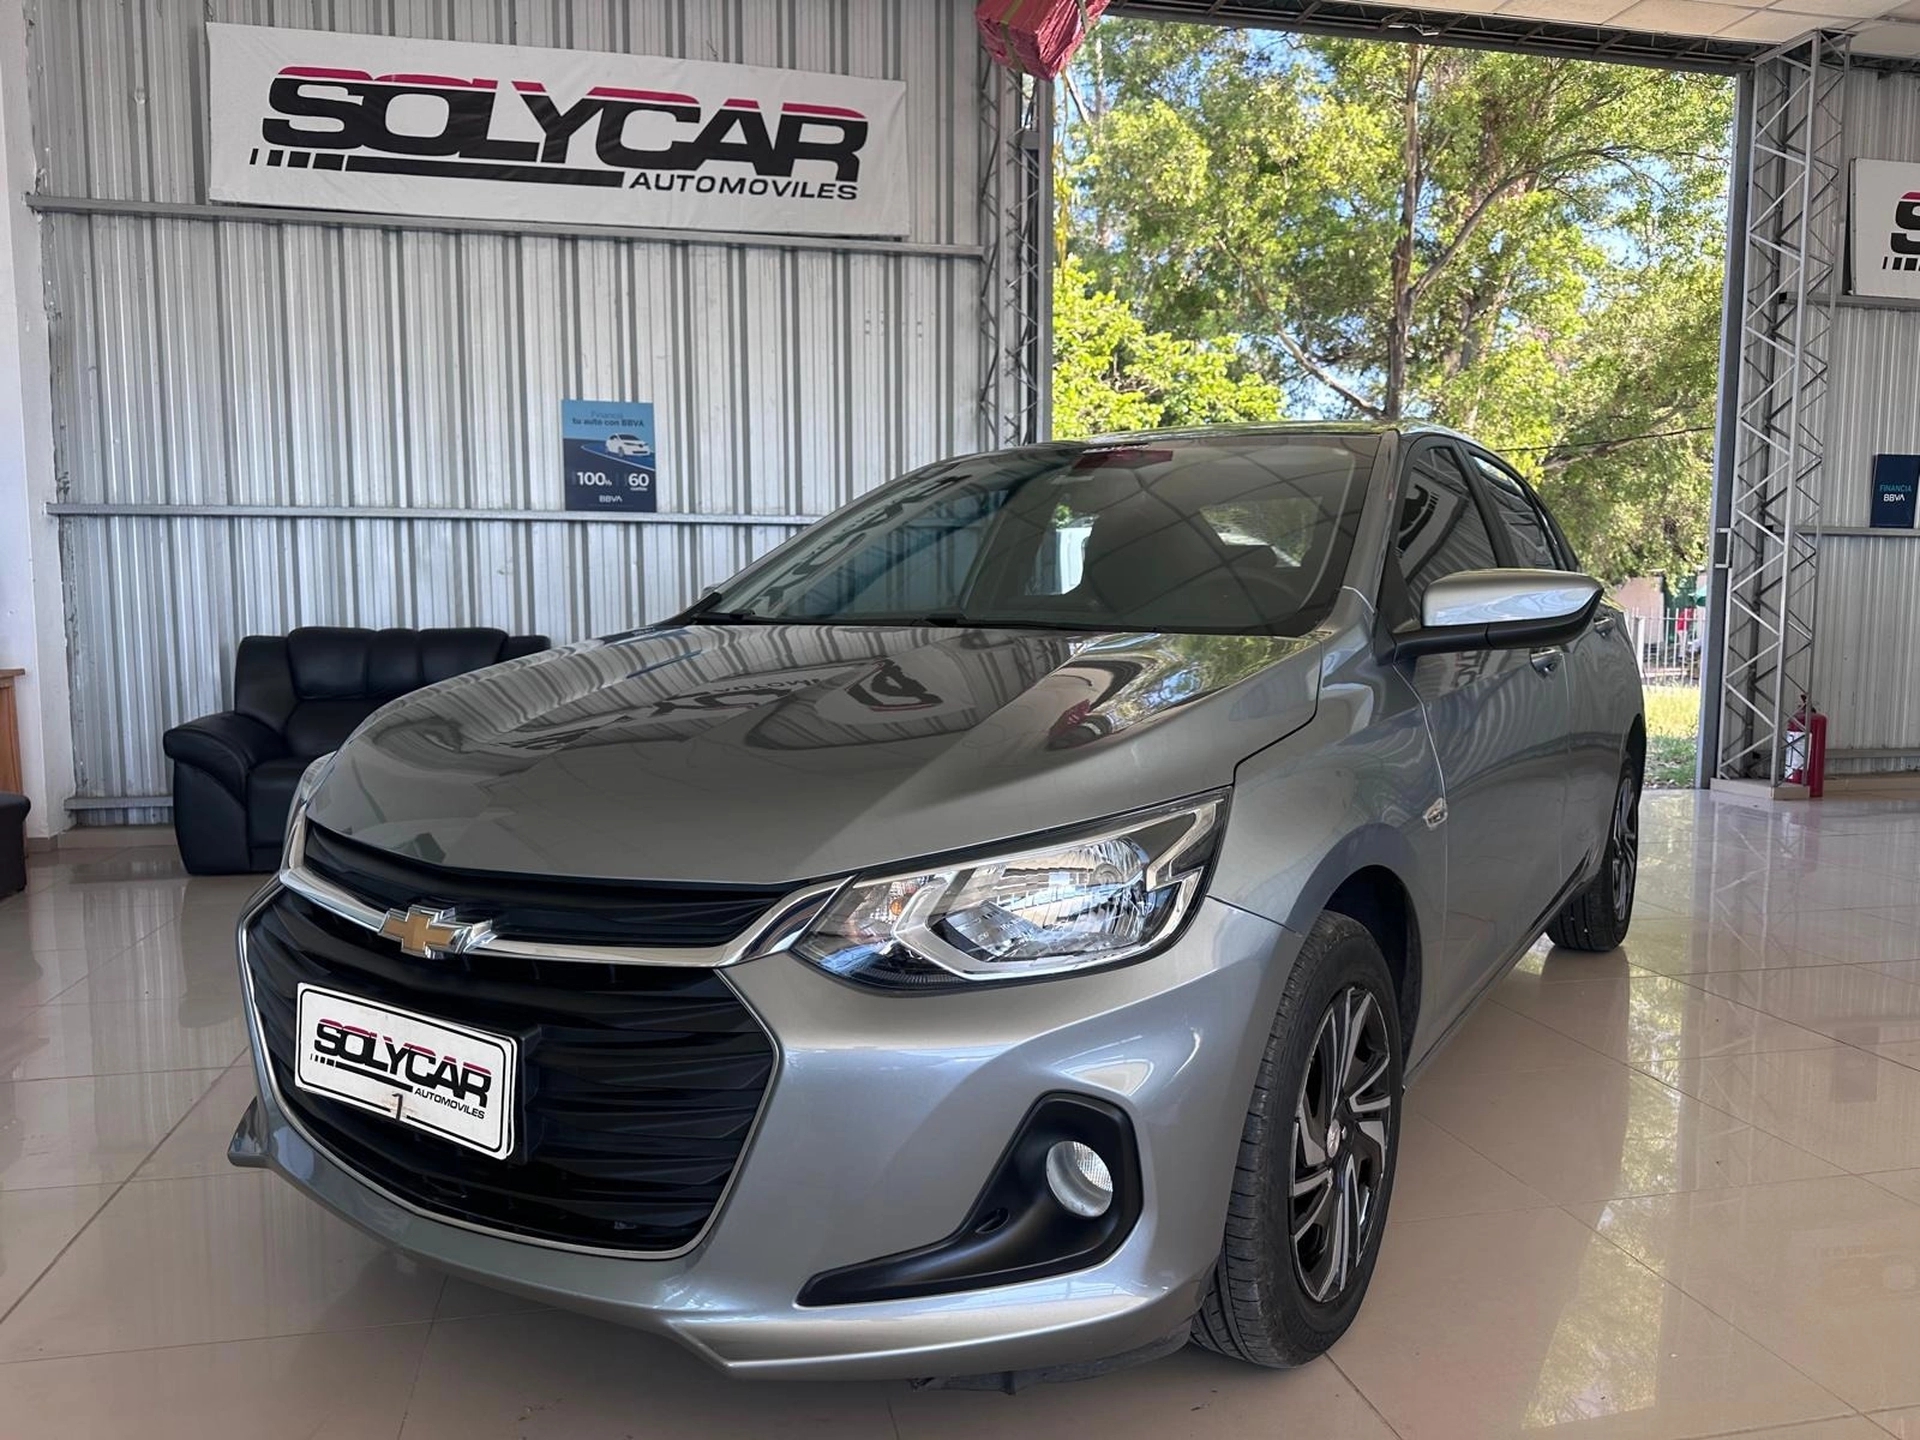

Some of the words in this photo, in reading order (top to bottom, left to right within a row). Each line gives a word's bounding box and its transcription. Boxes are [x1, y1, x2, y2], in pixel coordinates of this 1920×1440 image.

[262, 66, 868, 182] SOLYCAR
[629, 172, 858, 200] AUTOMOVILES
[621, 419, 644, 427] BBVA
[628, 473, 649, 486] 60
[1883, 493, 1905, 501] BBVA
[314, 1018, 492, 1108] SOLYCAR
[414, 1087, 486, 1120] AUTOMOVILES
